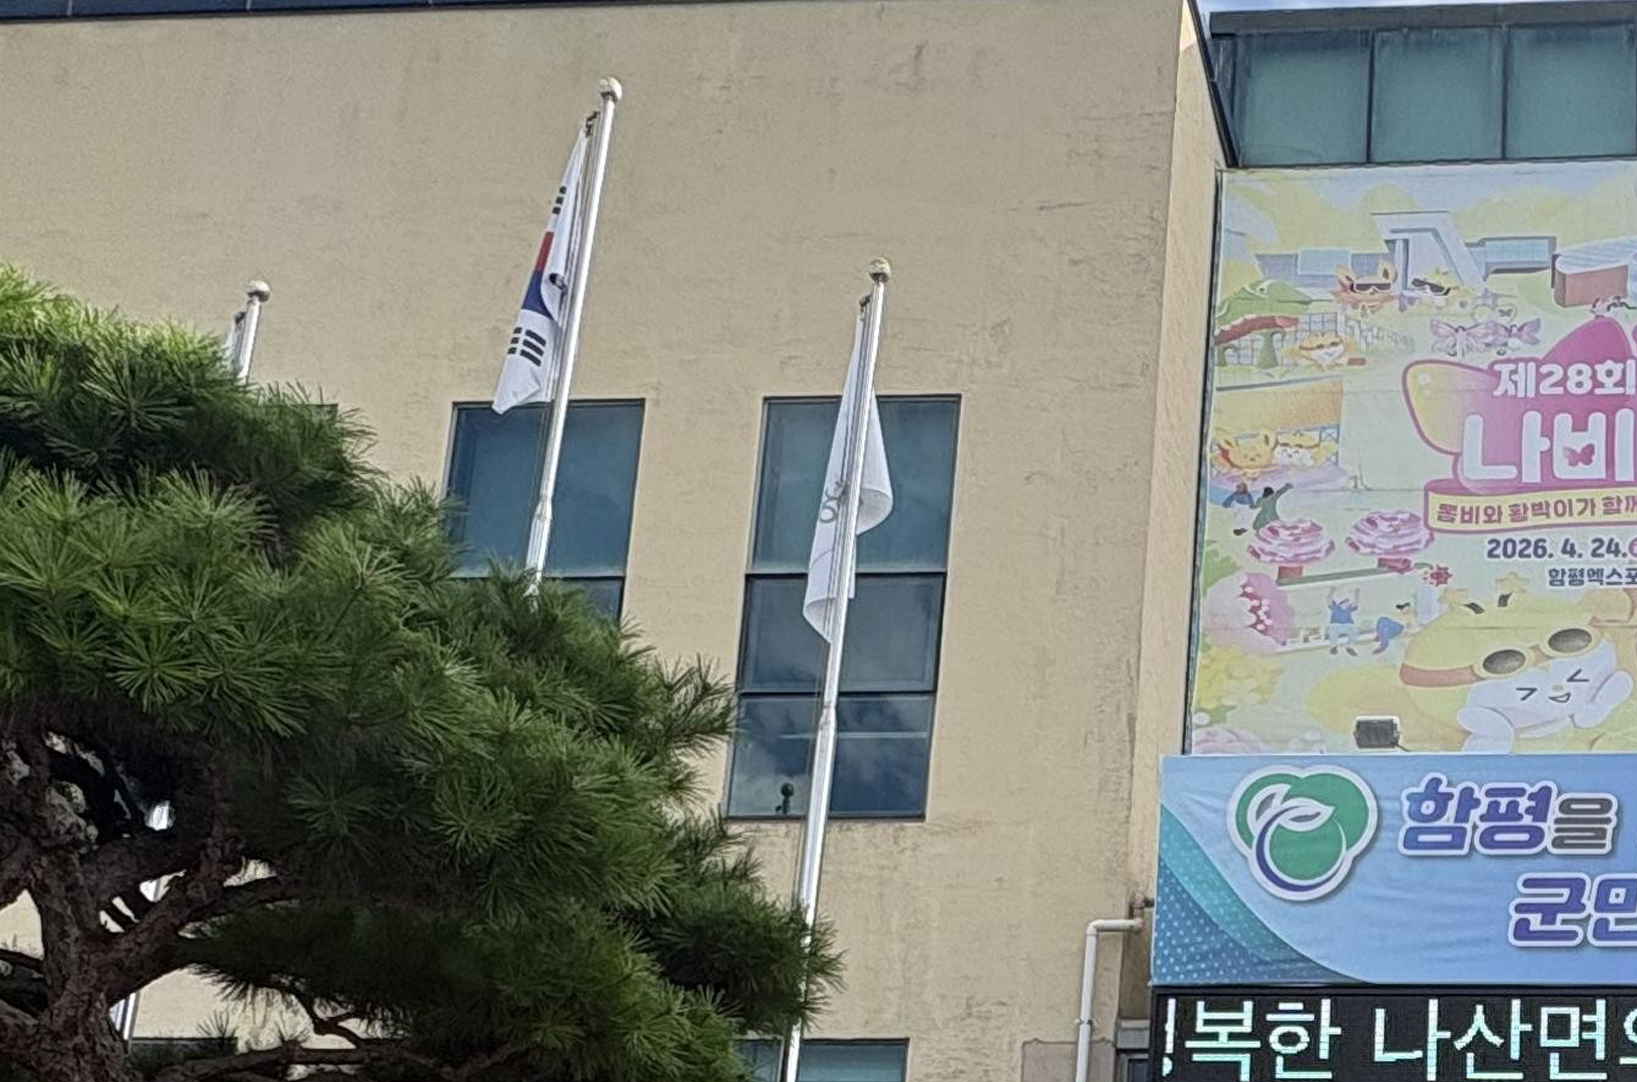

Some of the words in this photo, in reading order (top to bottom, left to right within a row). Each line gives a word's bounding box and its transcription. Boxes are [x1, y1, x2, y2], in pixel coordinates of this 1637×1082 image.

[1492, 360, 1637, 398] 제28회
[1487, 538, 1553, 559] 2026.
[1560, 538, 1583, 559] 4.
[1401, 775, 1613, 852] 함평을
